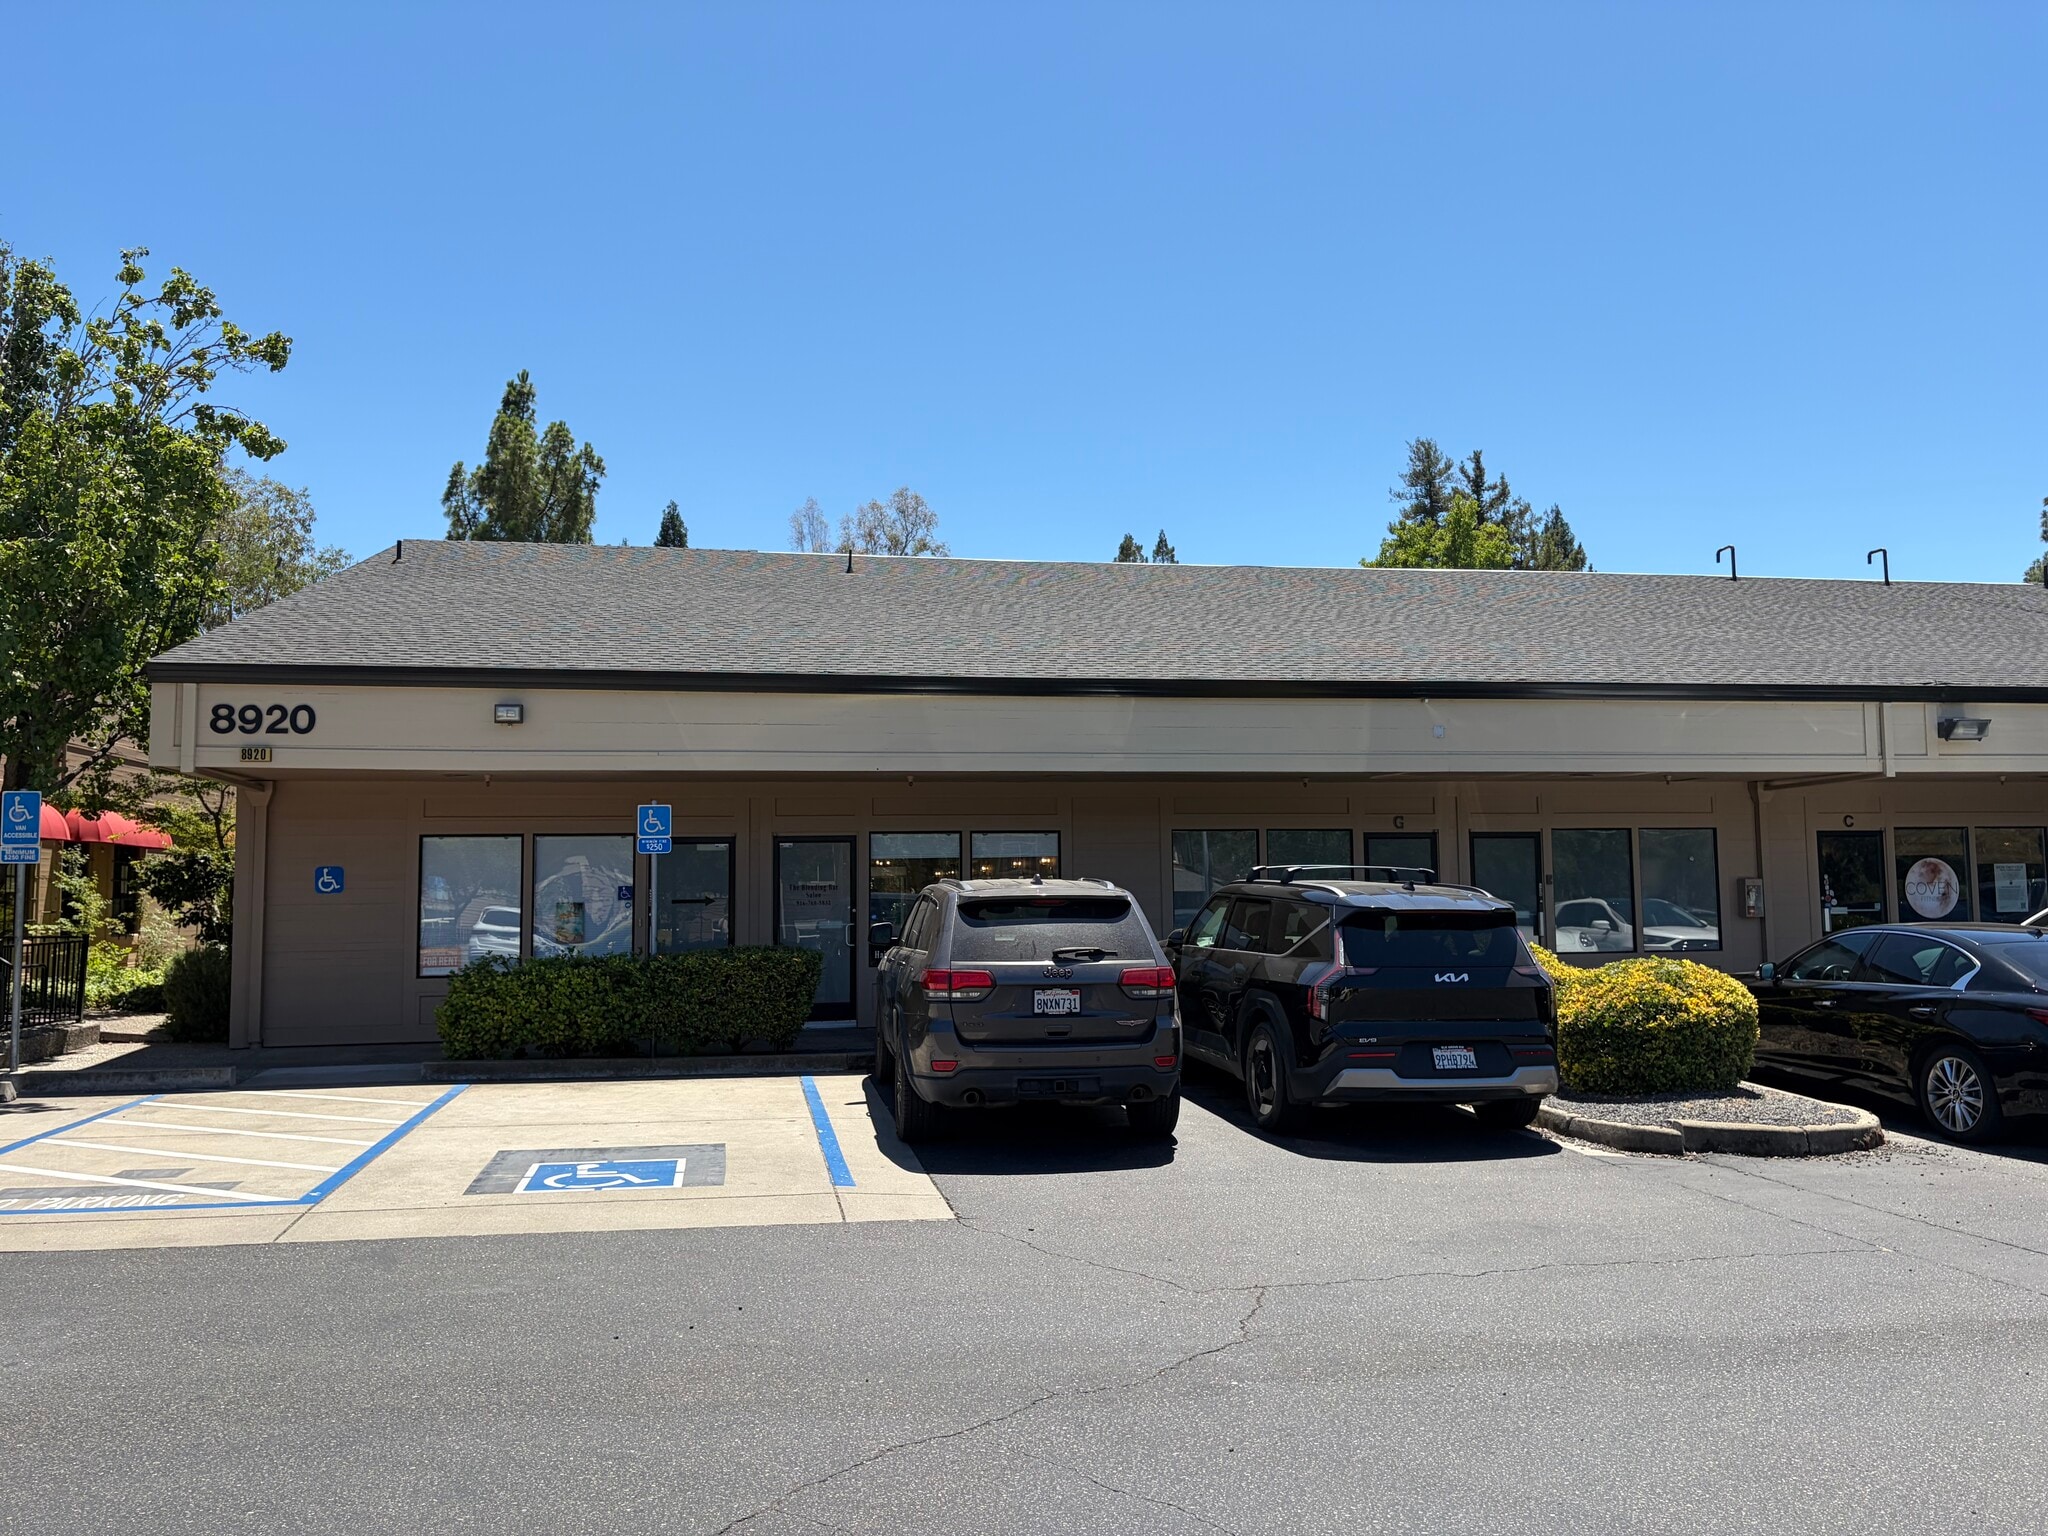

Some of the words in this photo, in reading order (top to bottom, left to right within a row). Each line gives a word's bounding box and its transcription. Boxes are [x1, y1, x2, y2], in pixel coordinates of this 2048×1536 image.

[209, 704, 316, 734] 8920
[241, 748, 266, 760] 8920
[1393, 816, 1404, 829] G
[1843, 815, 1854, 828] C
[646, 843, 663, 851] $250
[1906, 881, 1958, 896] COVEN
[422, 956, 438, 967] FOR
[438, 956, 458, 966] RENT
[1043, 966, 1073, 979] Jeep
[1434, 973, 1469, 982] KIA
[1036, 998, 1079, 1010] 8NXN731
[1435, 1054, 1475, 1067] 9PHB794
[22, 1194, 185, 1209] PARKING
